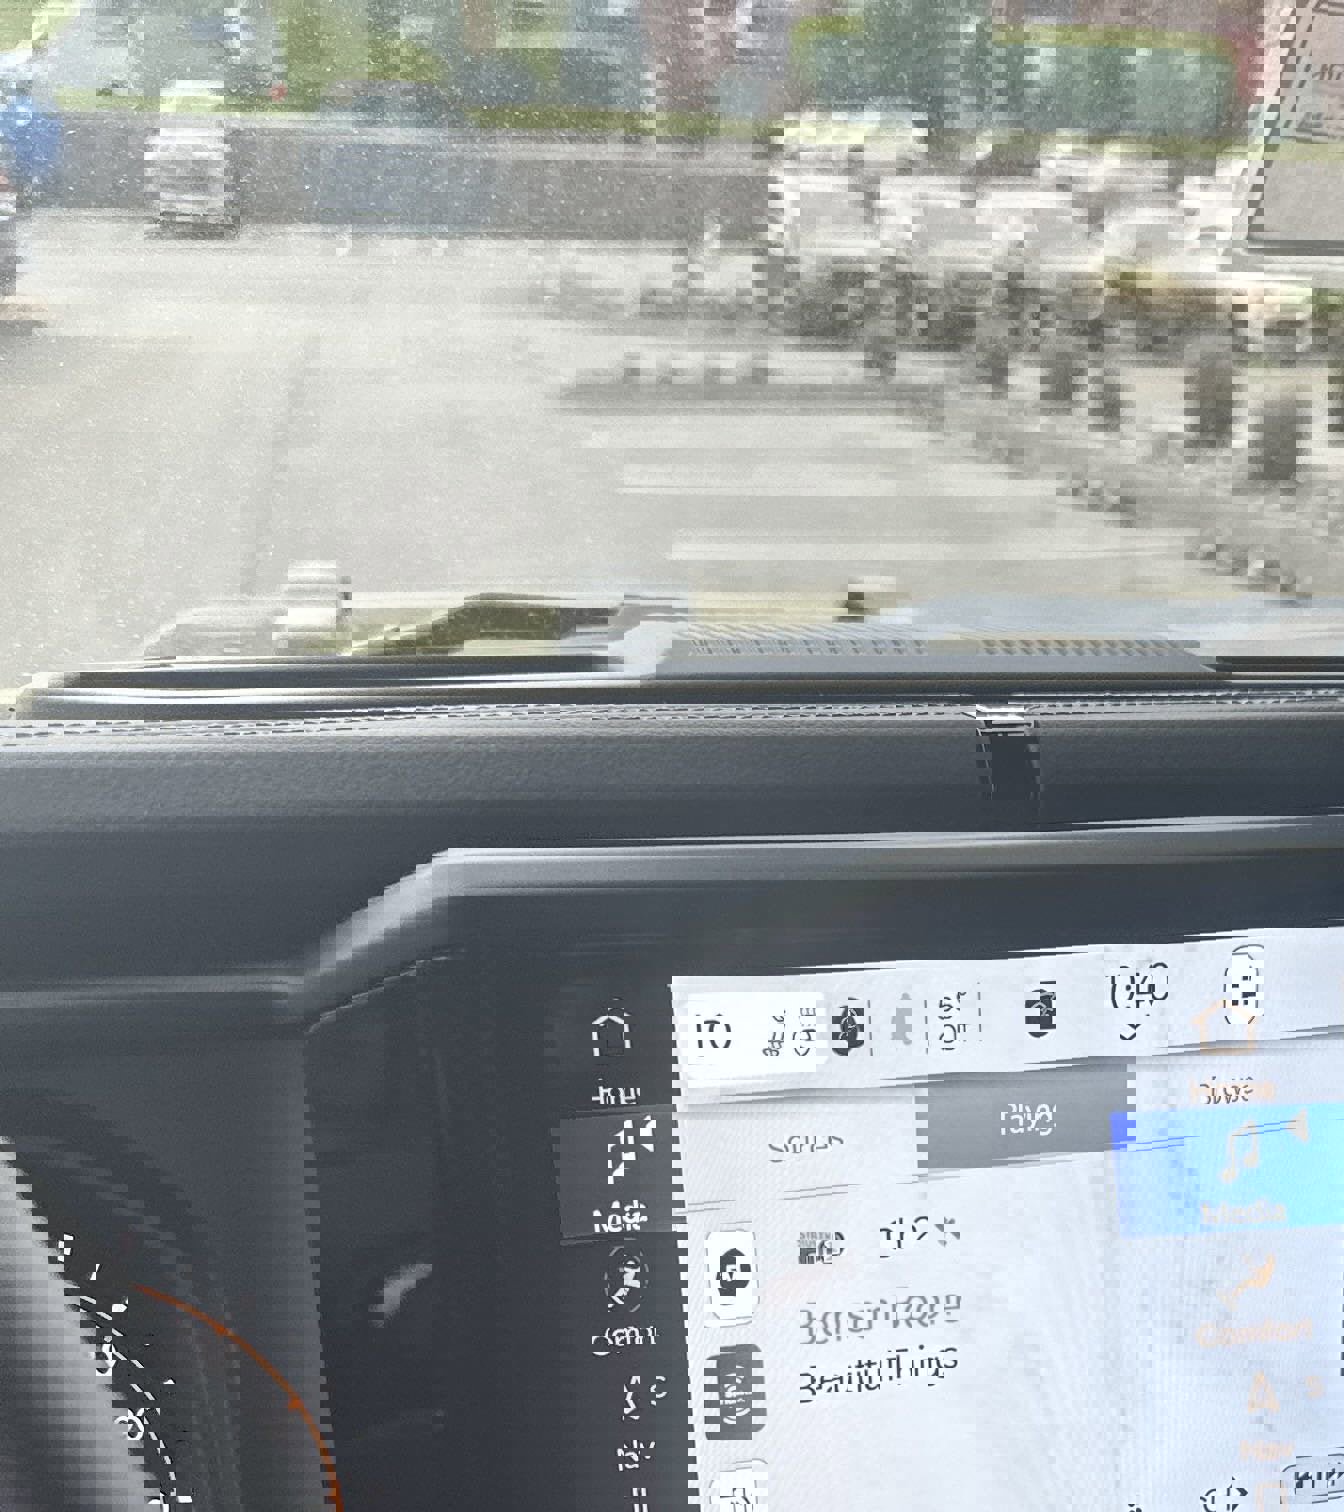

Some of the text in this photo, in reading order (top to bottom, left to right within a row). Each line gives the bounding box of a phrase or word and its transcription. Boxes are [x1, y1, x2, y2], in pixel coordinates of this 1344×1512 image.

[1190, 1077, 1277, 1103] Home
[1201, 1198, 1288, 1228] Media
[1197, 1318, 1316, 1348] Comfort
[1241, 1439, 1295, 1464] Nav
